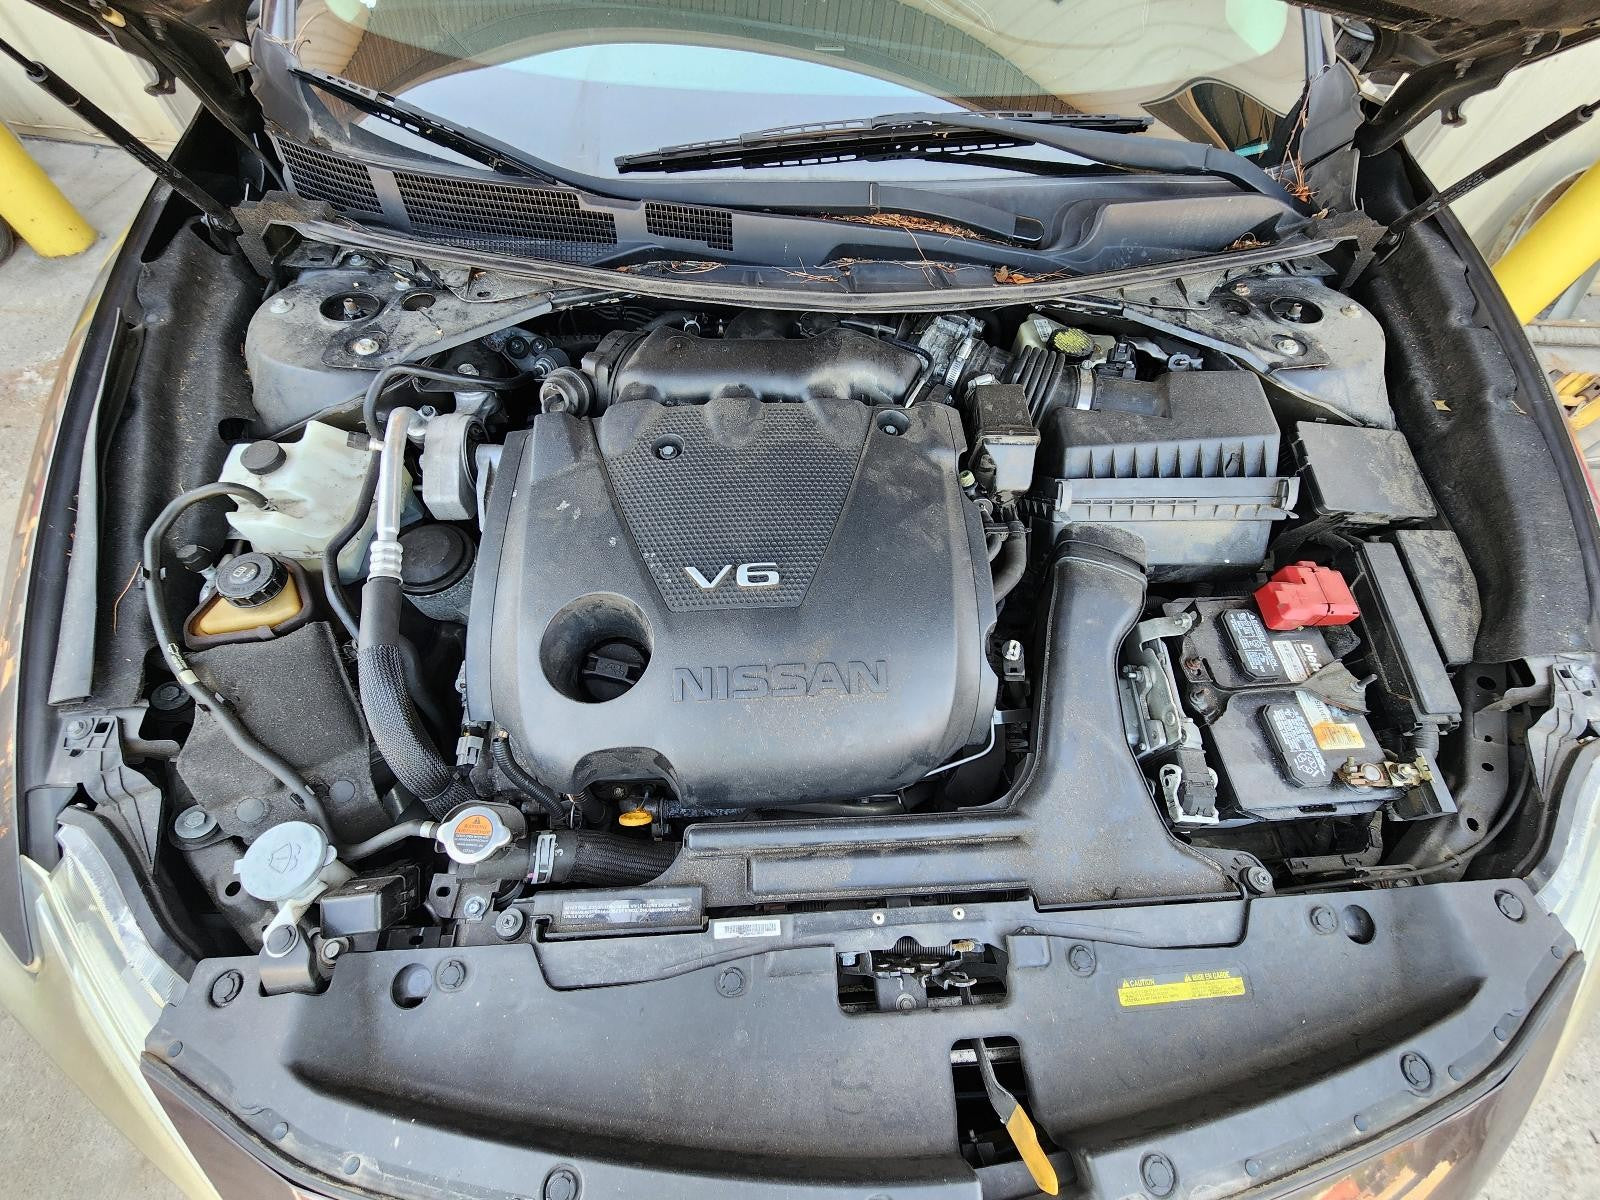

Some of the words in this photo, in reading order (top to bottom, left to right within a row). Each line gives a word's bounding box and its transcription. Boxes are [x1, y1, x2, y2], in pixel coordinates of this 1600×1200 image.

[684, 561, 780, 591] V6
[672, 659, 889, 702] NISSAN
[1129, 978, 1155, 988] CAUTION
